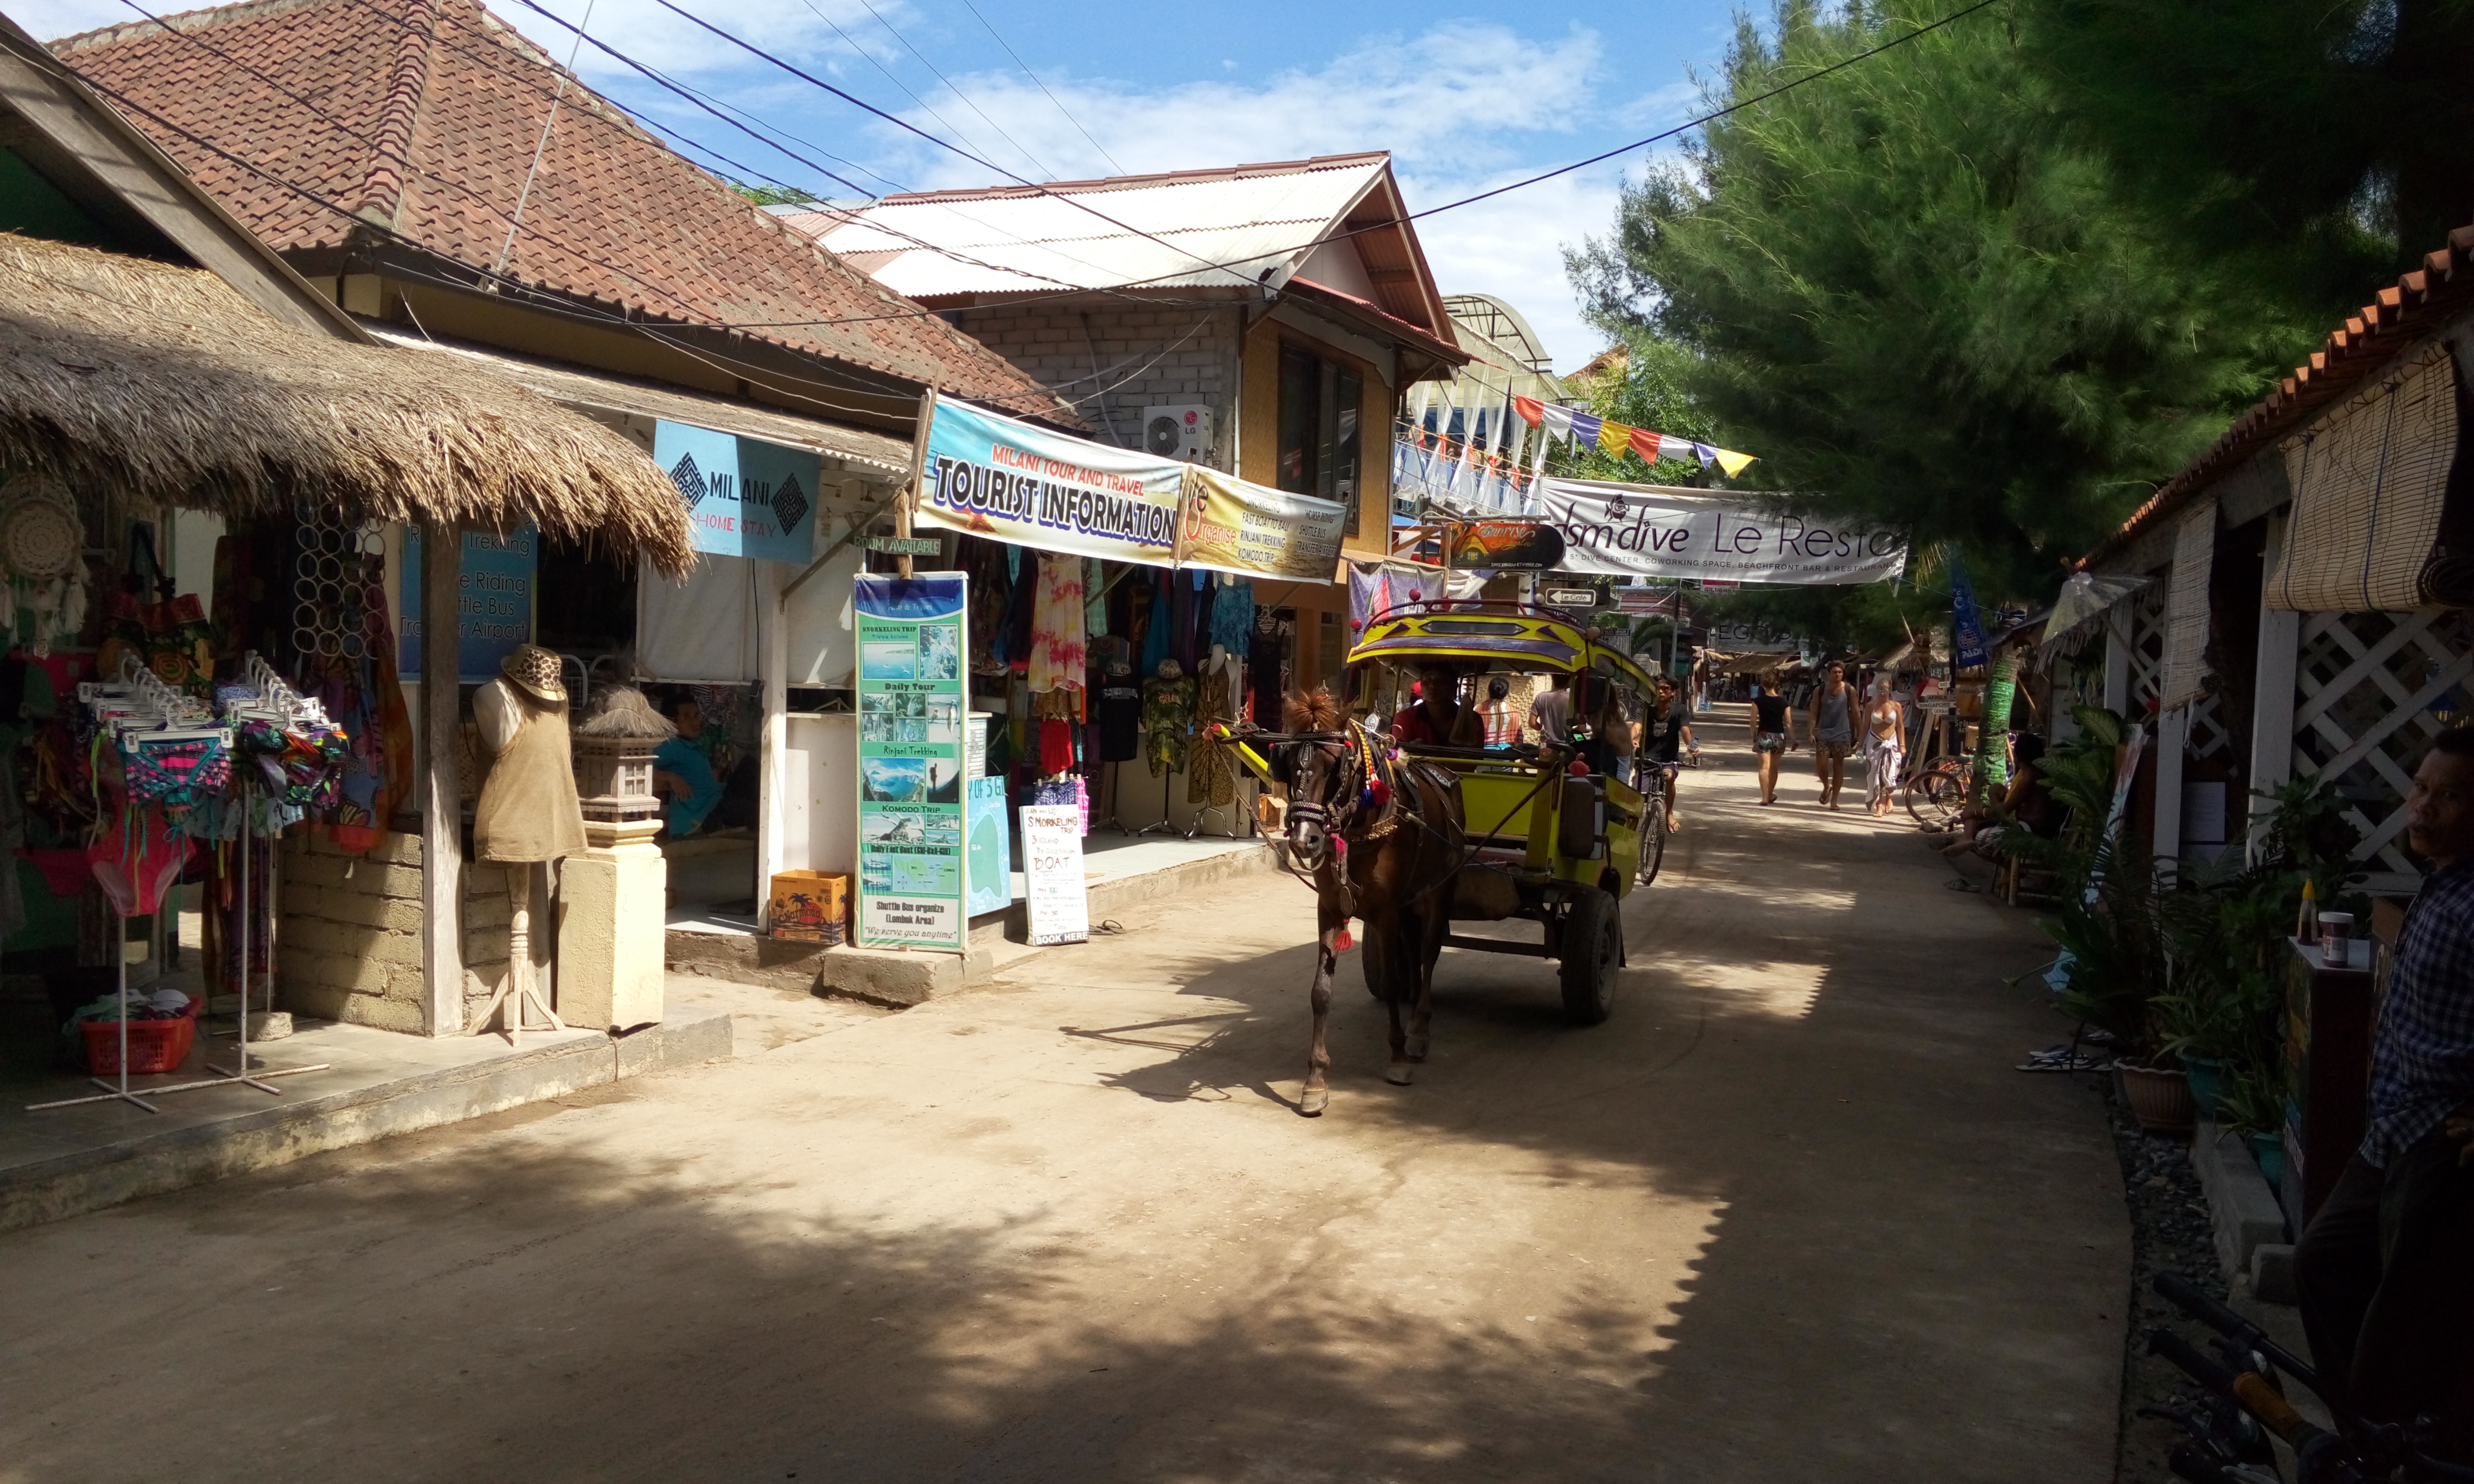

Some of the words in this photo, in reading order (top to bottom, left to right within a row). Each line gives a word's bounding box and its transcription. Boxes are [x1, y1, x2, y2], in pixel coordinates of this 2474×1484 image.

[991, 443, 1041, 473] MILANI
[1043, 459, 1075, 480] TOUR
[1077, 467, 1104, 487] AND
[1106, 473, 1144, 497] TRAVEL
[710, 471, 770, 506] MILANI
[935, 454, 1038, 520] TOURIST
[1040, 481, 1177, 544] INFORMATION
[1246, 496, 1281, 513] SNORKELING
[1242, 512, 1255, 525] FAST
[1255, 515, 1270, 527] BOAT
[1270, 518, 1278, 529] TO
[1278, 520, 1291, 532] BALI
[1304, 509, 1320, 521] HORSE
[696, 512, 736, 532] HOME
[740, 520, 776, 537] STAY
[1299, 524, 1318, 538] SHUTTLE
[1318, 527, 1326, 539] BUS
[468, 531, 530, 557] Trekking
[1240, 530, 1261, 544] RINJANI
[1262, 534, 1286, 548] TREKKING
[1715, 513, 1762, 554] Le
[1779, 515, 1897, 558] Resto
[855, 536, 885, 551] ROOM
[889, 538, 940, 554] AVAILABLE
[1296, 540, 1318, 554] TRANSFER
[1319, 544, 1337, 557] AIRPORT
[1238, 547, 1264, 562] KOMODO
[1264, 552, 1275, 564] TRIP
[1581, 554, 1601, 562] DIVE
[1604, 555, 1642, 564] CENTER,
[1645, 557, 1699, 567] COWORKING
[1702, 560, 1735, 569] SPACE,
[1738, 562, 1800, 571] BEACHFRONT
[1834, 561, 1895, 572] RESTAURANT
[475, 571, 525, 596] Riding
[1571, 593, 1587, 601] Café
[488, 597, 515, 616] Bus
[471, 619, 526, 642] Airport
[1962, 648, 1983, 659] PADI
[885, 683, 910, 691] Daily
[884, 745, 907, 757] Rinjani
[909, 746, 938, 757] Trekking
[974, 779, 984, 799] OF
[986, 777, 992, 798] 3
[882, 804, 919, 813] KOMODO
[1028, 816, 1078, 828] SNORKELING
[1032, 835, 1037, 844] 3
[871, 845, 885, 854] Daily
[886, 845, 898, 854] Fast
[1033, 856, 1070, 870] BOAT
[876, 900, 901, 911] Shuttle
[902, 902, 914, 911] Bus
[915, 903, 945, 913] organize
[886, 914, 913, 924] (Lombok
[915, 915, 935, 925] Area)
[1035, 934, 1062, 945] BOOK
[1064, 931, 1088, 941] HERE
